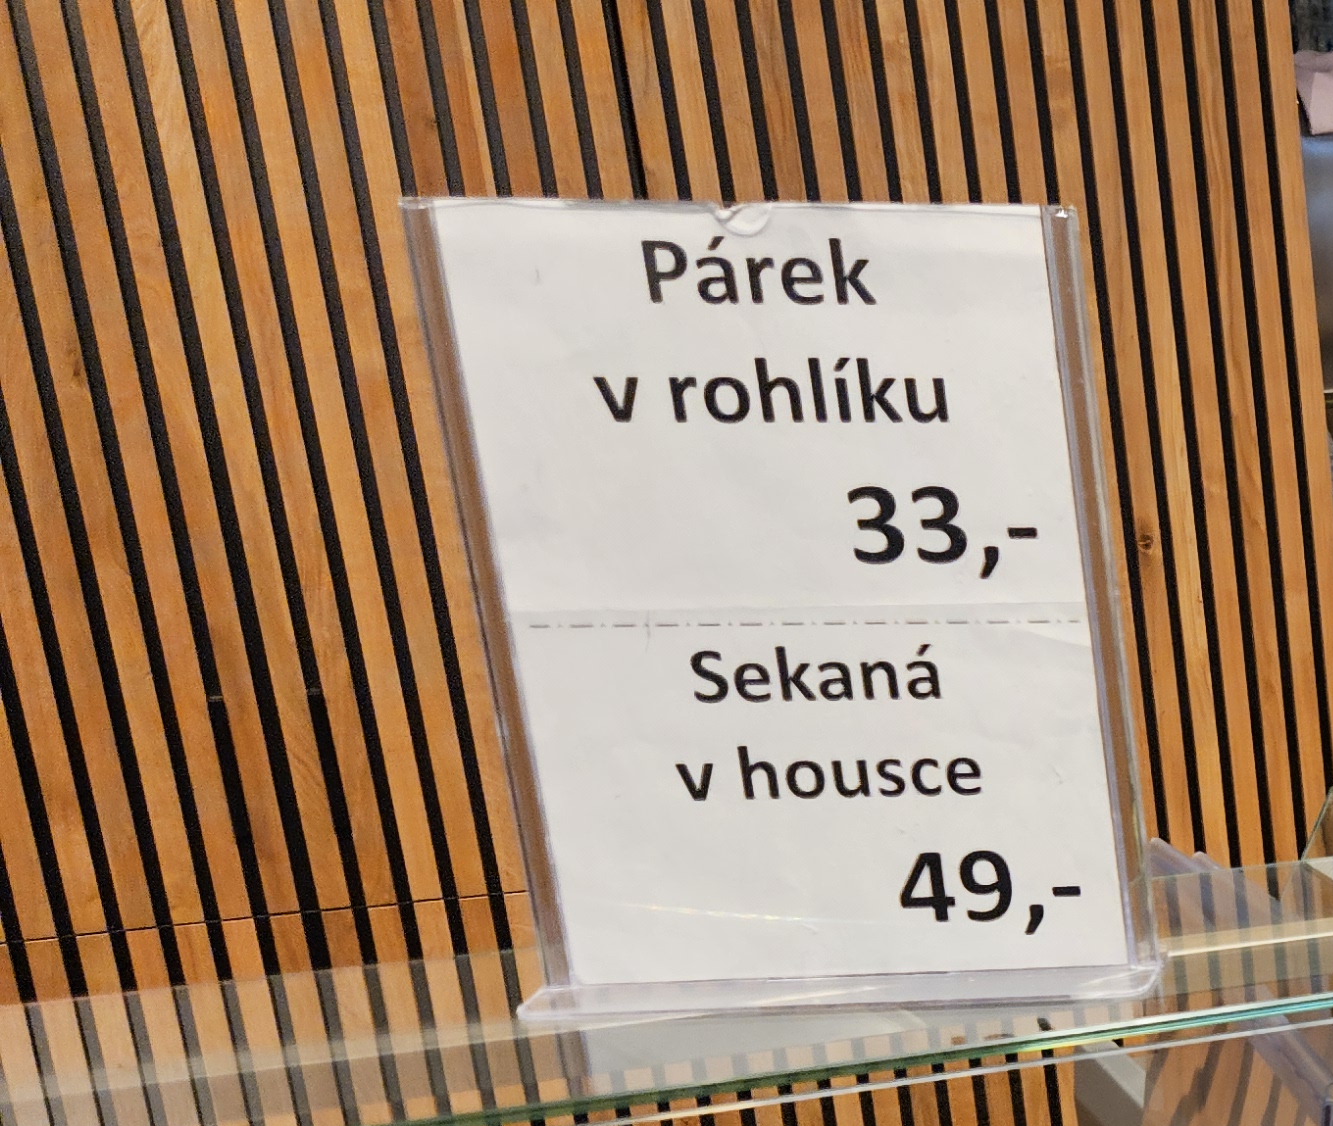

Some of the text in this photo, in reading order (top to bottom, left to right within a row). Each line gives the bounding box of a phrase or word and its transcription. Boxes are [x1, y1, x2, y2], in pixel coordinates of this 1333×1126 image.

[640, 236, 878, 306] Párek
[593, 357, 951, 424] v rohlíku
[846, 485, 1038, 579] 33,-
[689, 643, 944, 703] Sekaná
[675, 746, 984, 802] v housce
[899, 849, 1082, 936] 49,-
